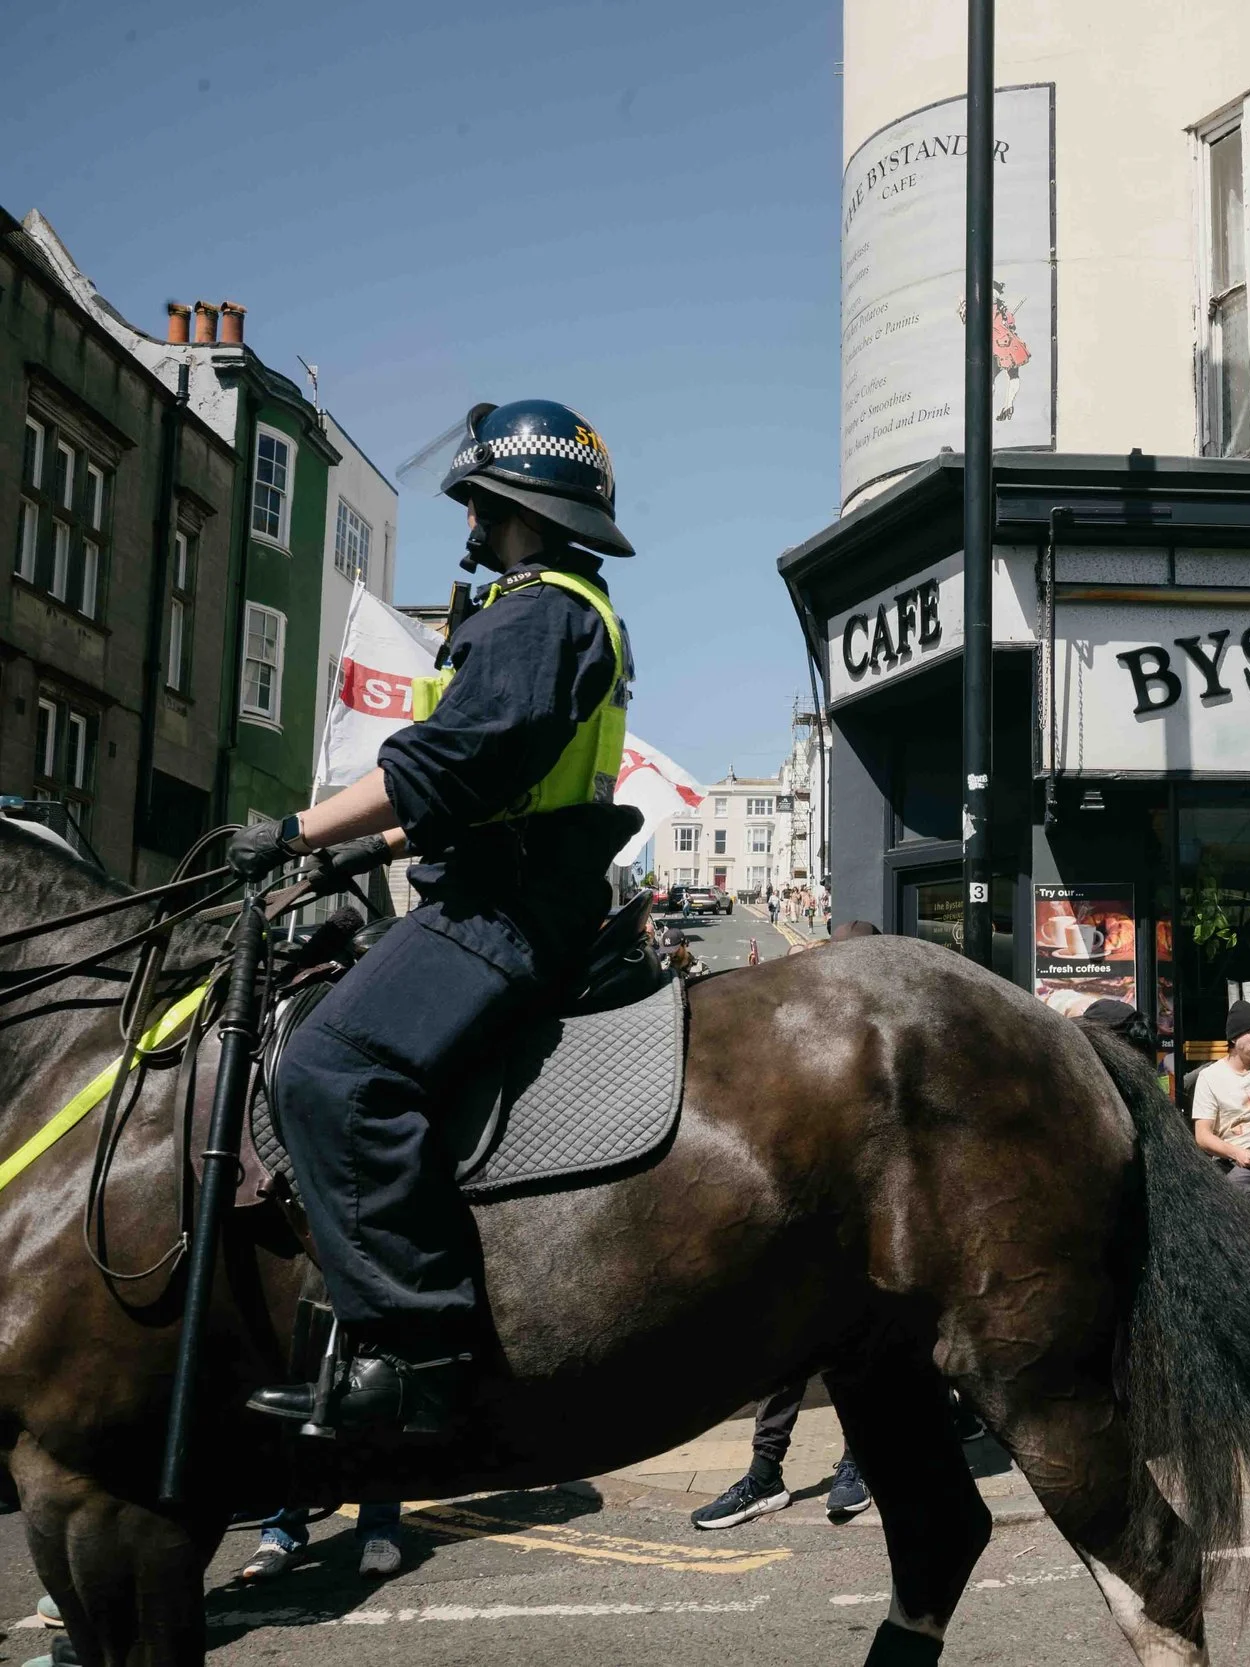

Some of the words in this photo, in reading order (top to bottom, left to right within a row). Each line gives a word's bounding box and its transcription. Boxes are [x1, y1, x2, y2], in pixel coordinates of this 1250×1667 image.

[867, 135, 1010, 191] BYSTANDR
[881, 173, 917, 200] CAFE
[859, 302, 889, 328] Potatoes
[884, 311, 920, 335] Paninis
[860, 376, 887, 398] Coffees
[867, 391, 912, 418] Smoothies
[871, 418, 894, 441] Food
[895, 410, 915, 430] and
[917, 402, 951, 423] Drink
[506, 571, 532, 585] 5199
[843, 578, 941, 674] CAFE
[973, 885, 984, 900] 3
[1039, 887, 1056, 899] Try
[1075, 963, 1111, 973] coffees
